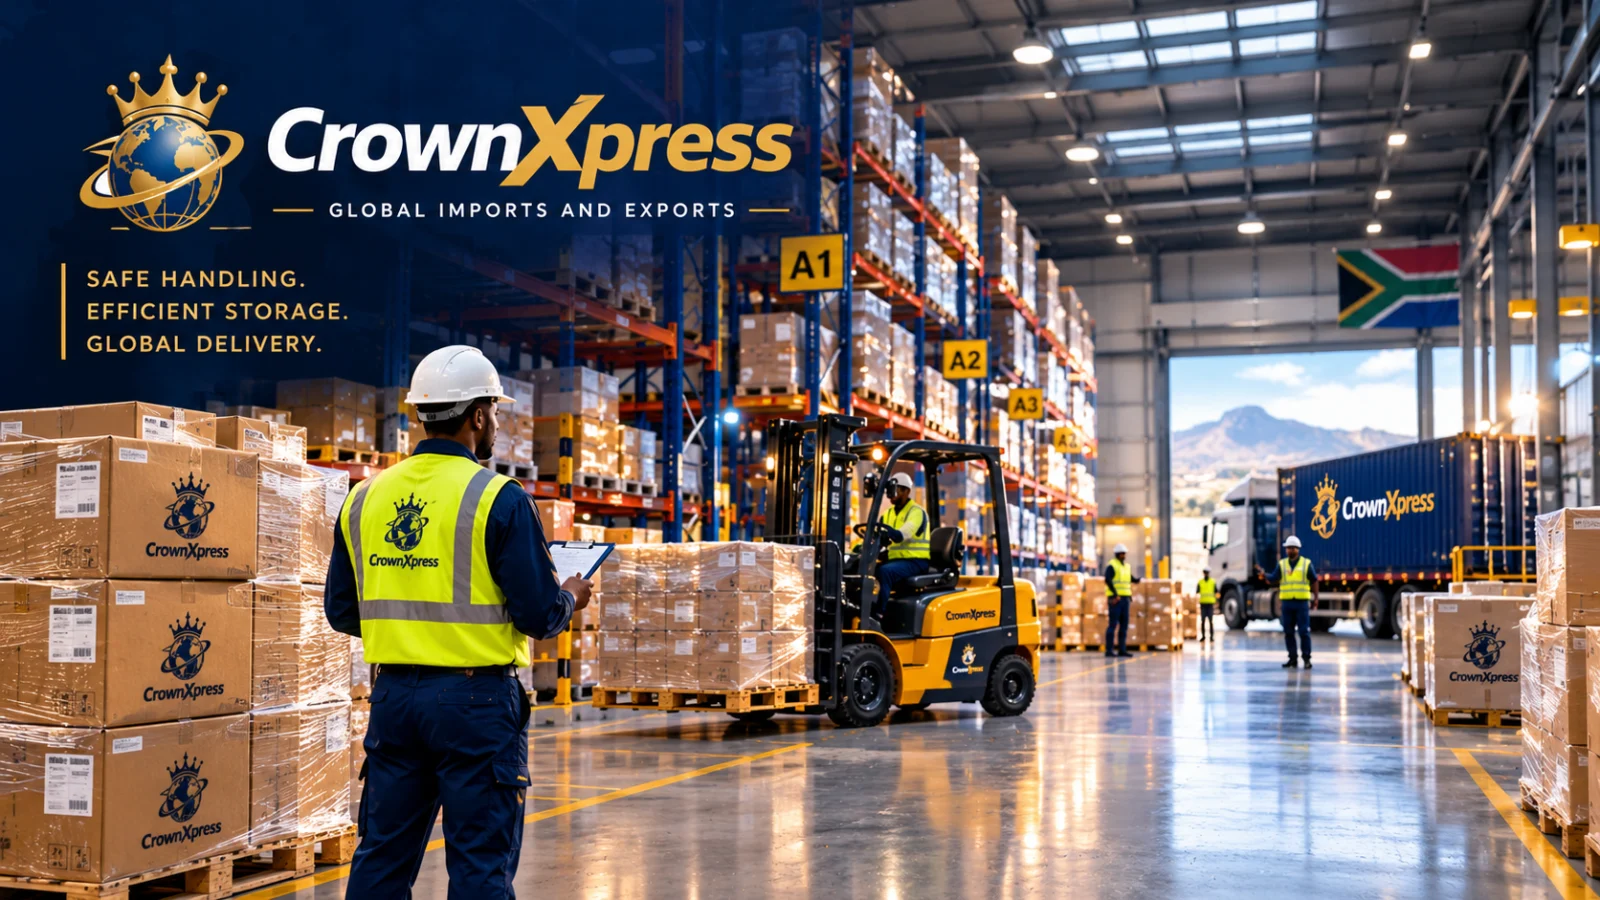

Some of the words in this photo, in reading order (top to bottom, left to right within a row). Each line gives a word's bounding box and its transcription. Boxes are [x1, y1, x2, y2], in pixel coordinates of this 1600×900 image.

[789, 249, 832, 280] A1
[949, 350, 981, 371] A2
[1013, 396, 1038, 413] A3
[1342, 490, 1435, 521] CrownXpress
[145, 541, 229, 561] CrownXpress
[368, 553, 439, 570] CrownXpress
[945, 609, 996, 621] CrownXpress
[1449, 671, 1520, 685] CrownXpress
[143, 682, 225, 702] CrownXpress
[141, 821, 222, 850] CrownXpress
